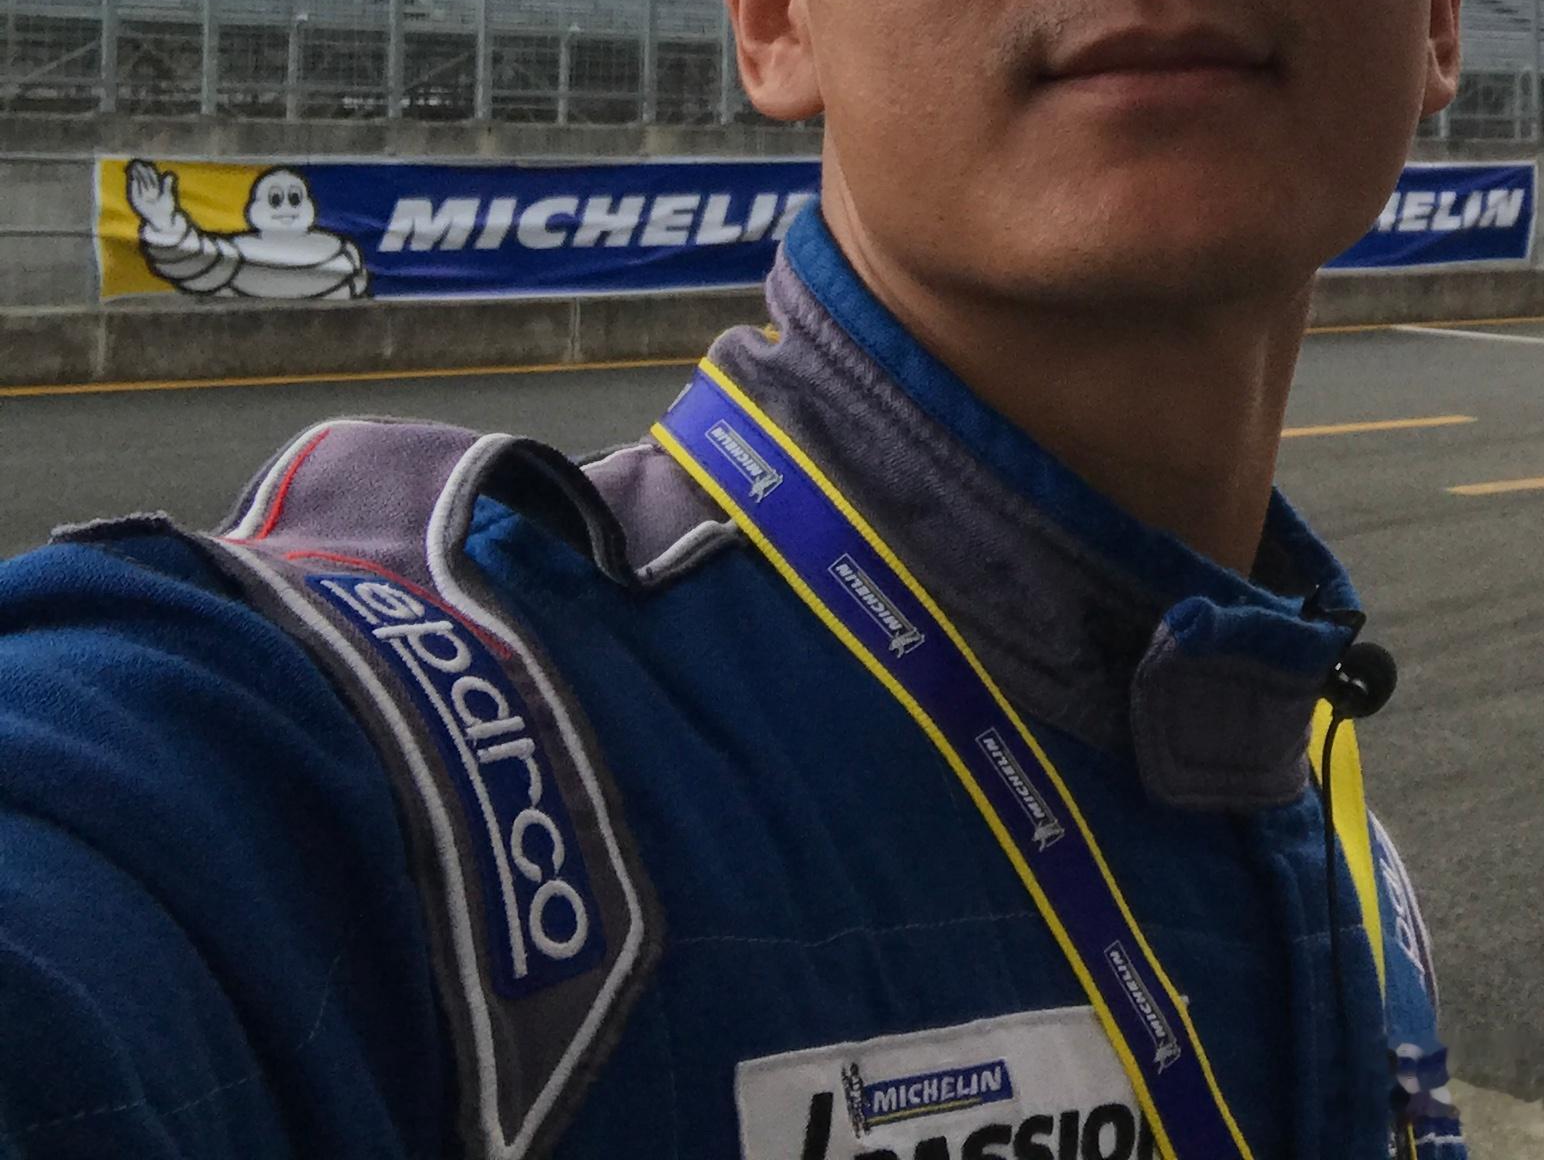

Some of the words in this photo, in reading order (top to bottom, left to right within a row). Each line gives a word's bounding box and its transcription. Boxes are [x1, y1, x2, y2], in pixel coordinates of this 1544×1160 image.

[710, 425, 765, 478] MICHELIN
[835, 562, 903, 630] MICHELIN
[350, 580, 589, 961] sparco
[982, 737, 1046, 819] MICHELIN
[1109, 949, 1167, 1039] MICHELIN
[870, 1065, 1003, 1114] MICHELIN
